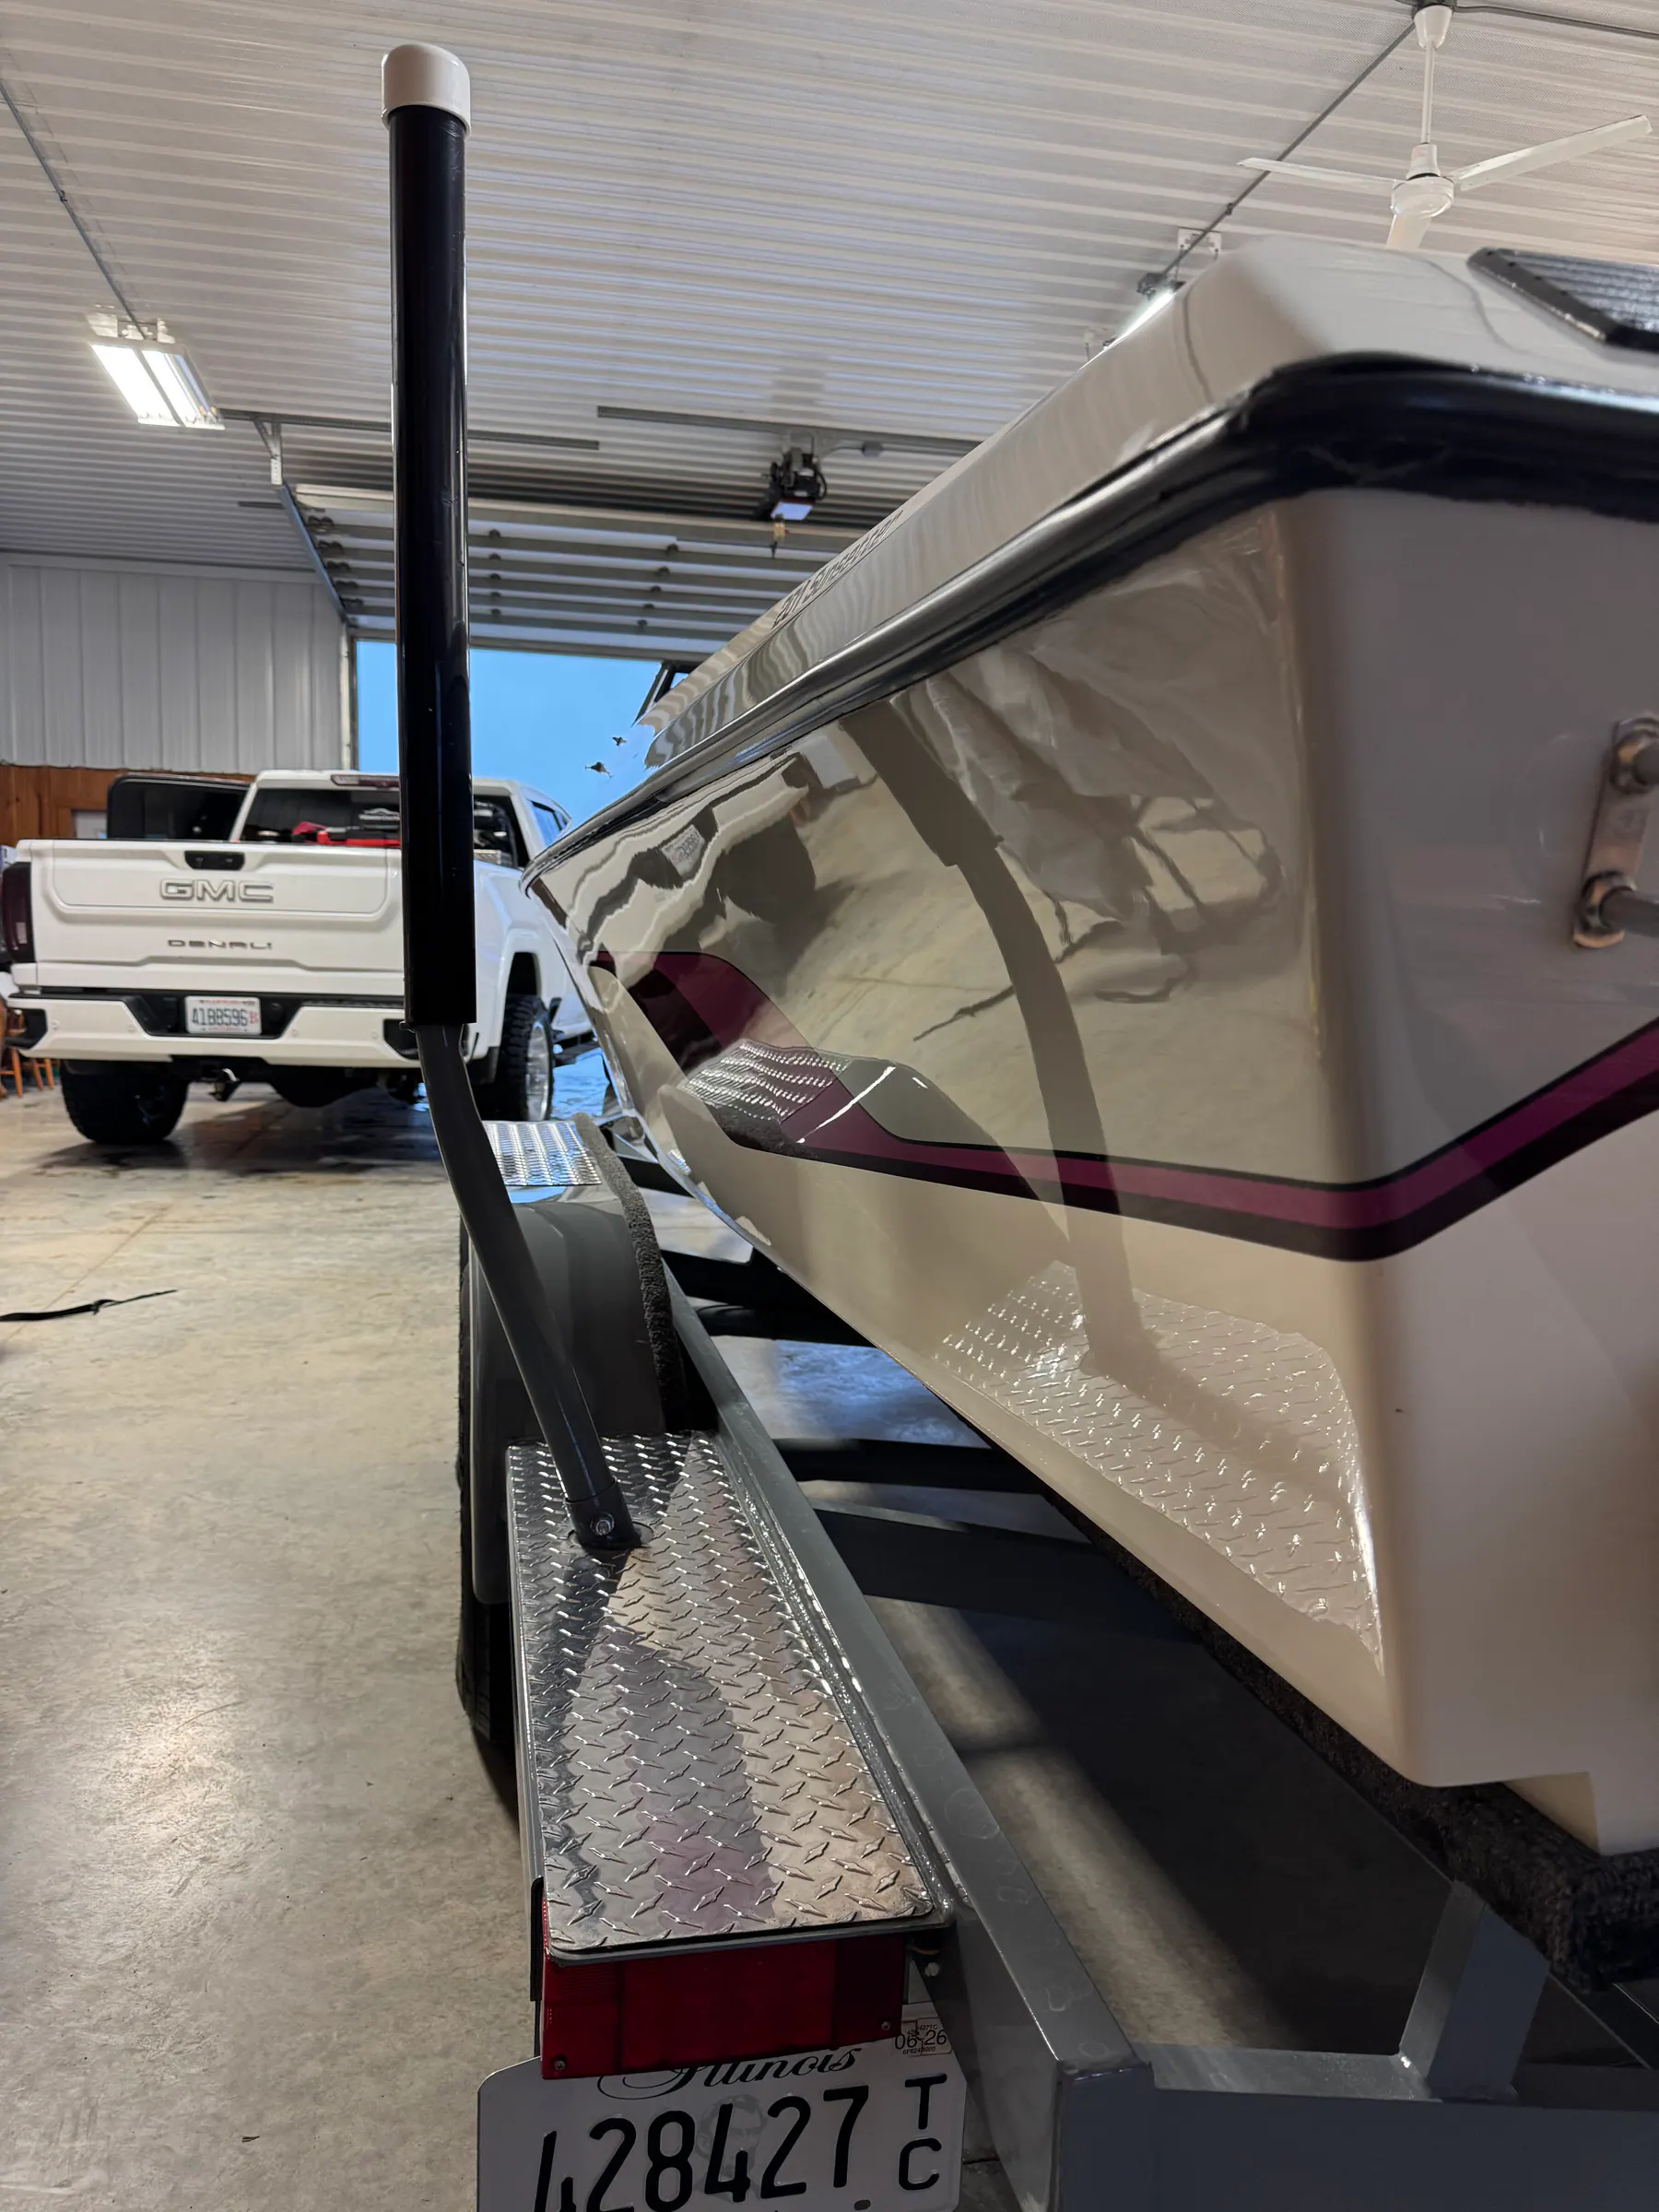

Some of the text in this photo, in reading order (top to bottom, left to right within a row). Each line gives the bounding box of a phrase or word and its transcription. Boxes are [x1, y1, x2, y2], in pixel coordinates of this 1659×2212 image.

[160, 878, 274, 903] GMC
[168, 938, 273, 950] DENALI
[532, 2083, 870, 2212] 428427
